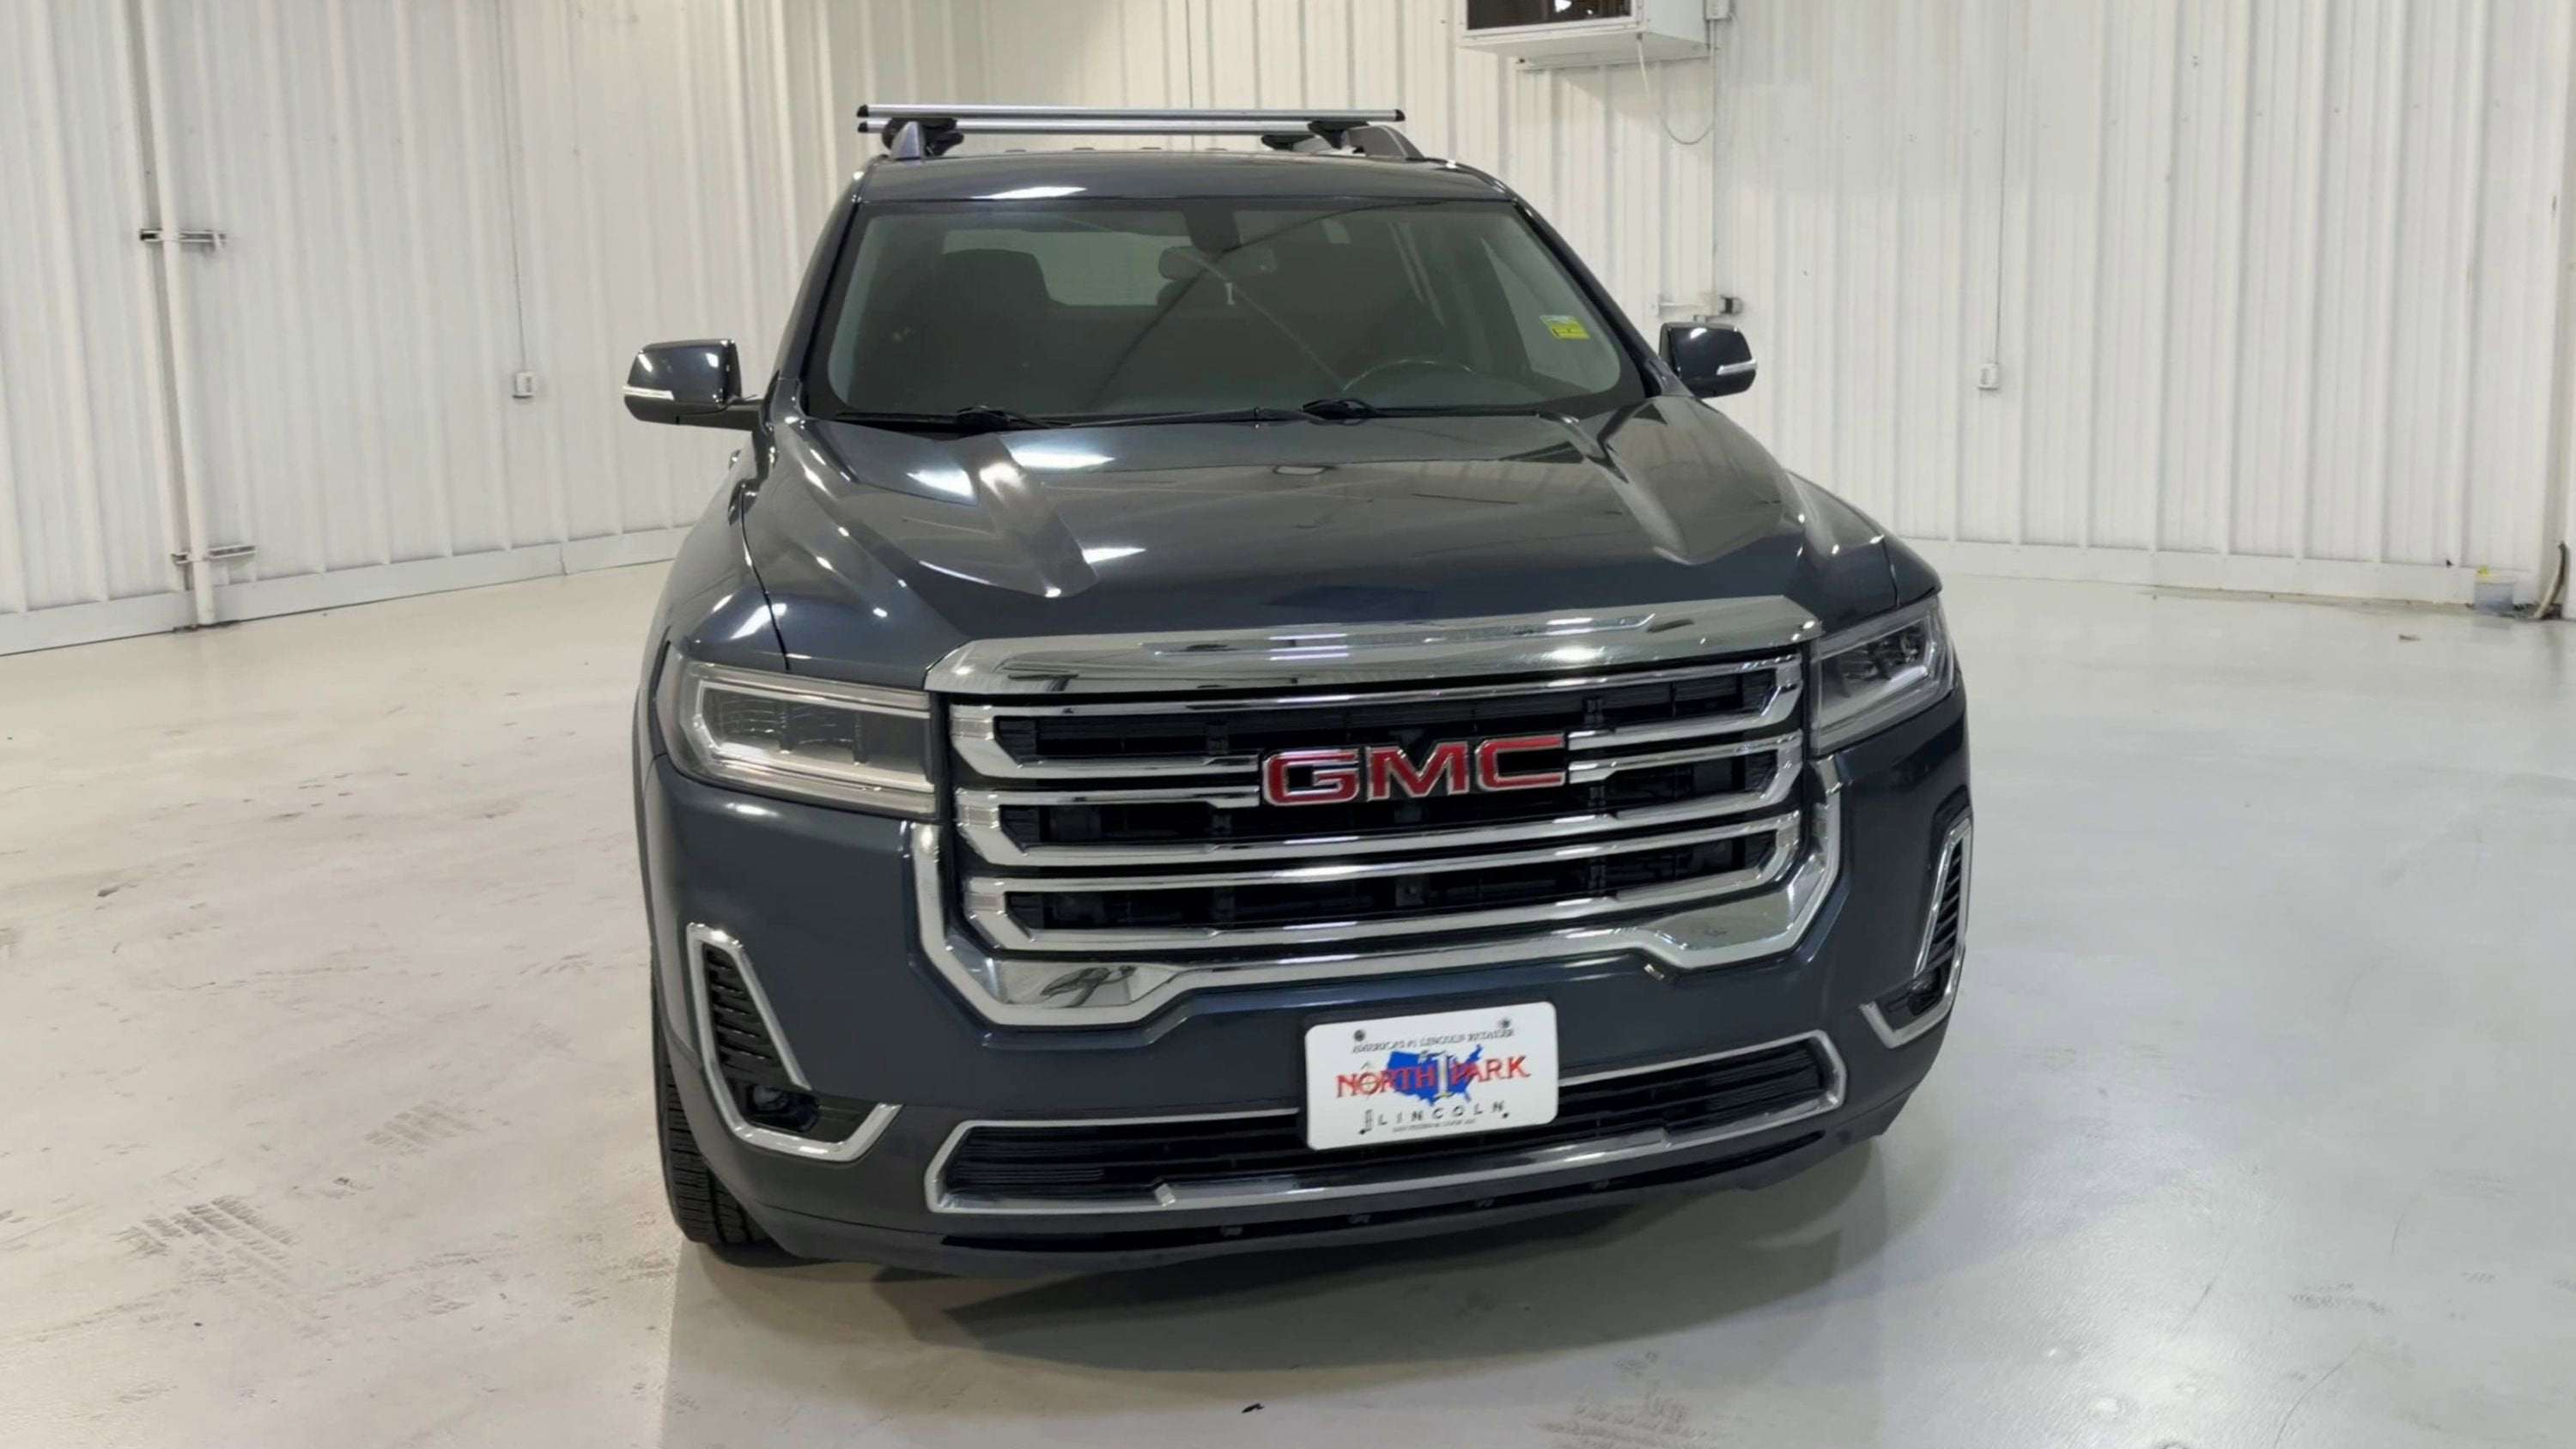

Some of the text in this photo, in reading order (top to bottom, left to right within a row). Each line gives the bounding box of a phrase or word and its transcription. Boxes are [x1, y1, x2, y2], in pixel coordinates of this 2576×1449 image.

[1263, 732, 1565, 806] GMC
[1335, 1055, 1531, 1098] NORTH PARK
[1377, 1100, 1504, 1125] LINCOLN
